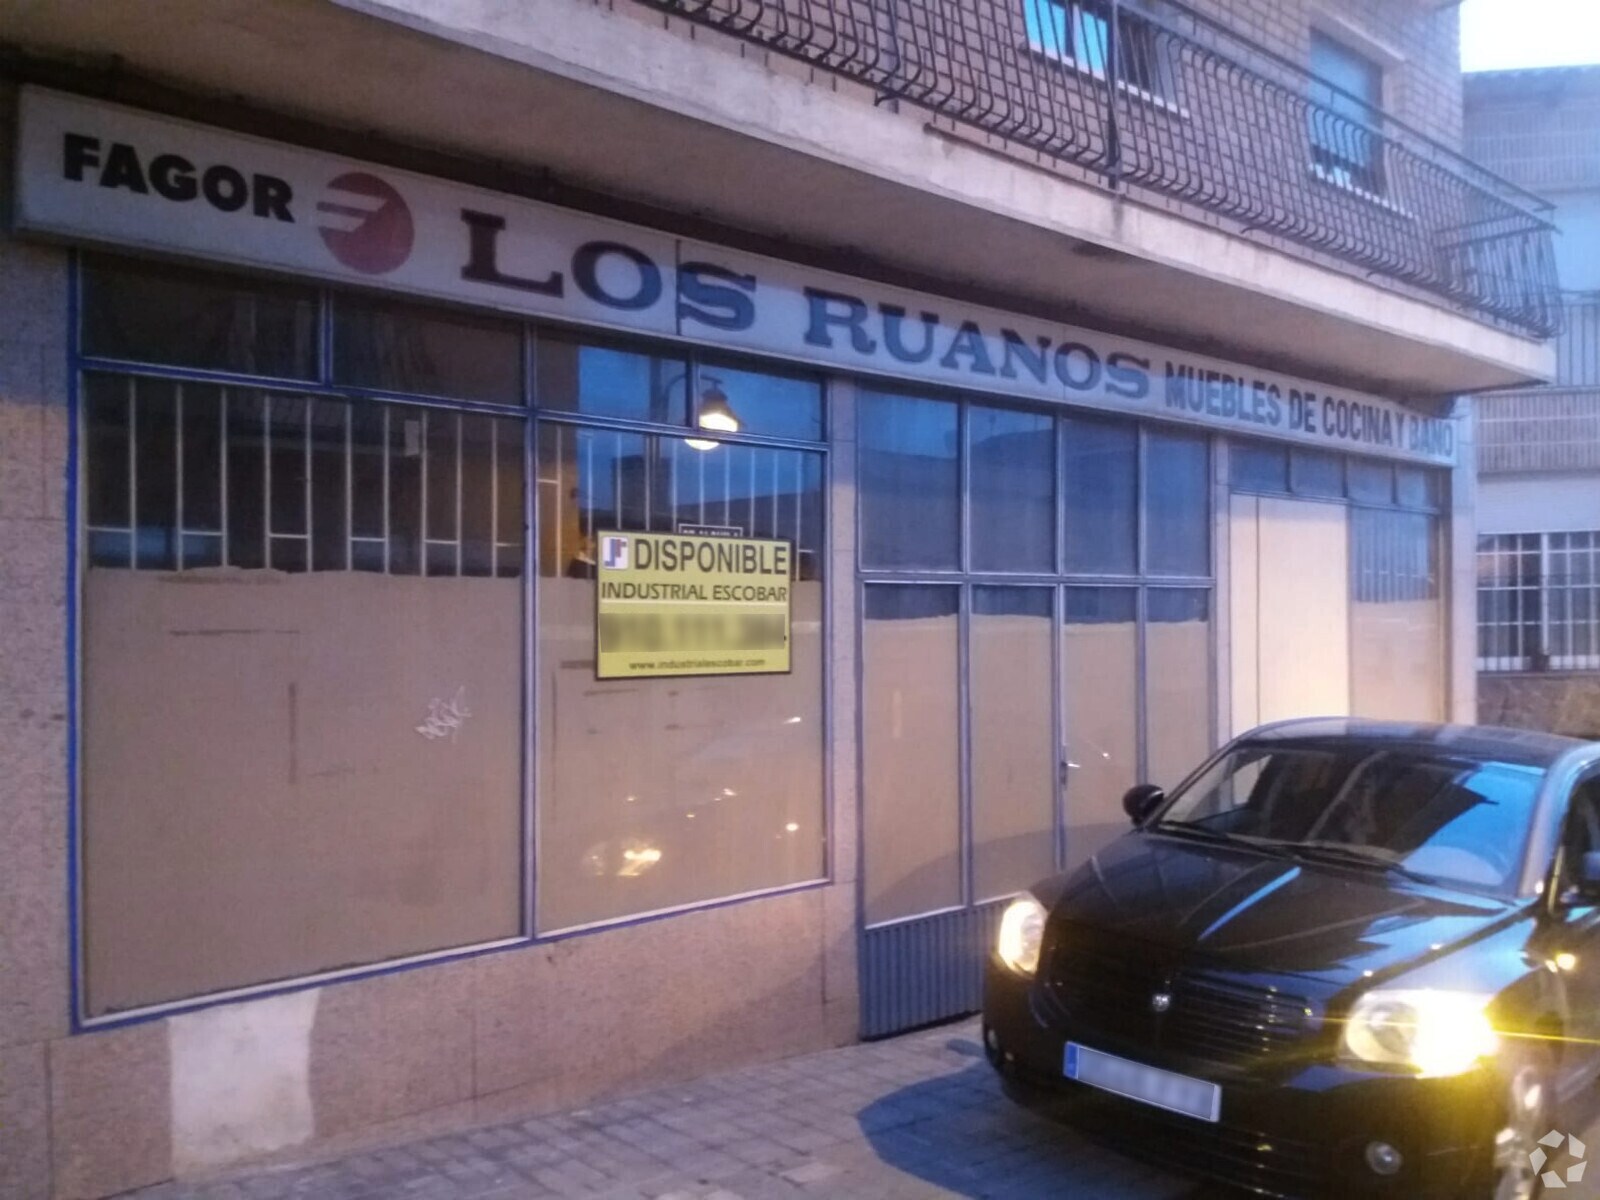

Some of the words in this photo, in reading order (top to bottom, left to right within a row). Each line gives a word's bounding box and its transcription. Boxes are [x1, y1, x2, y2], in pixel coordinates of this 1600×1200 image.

[63, 132, 295, 222] FAGOR
[460, 208, 757, 332] LOS
[803, 286, 1150, 399] RUANOS
[1165, 361, 1281, 427] MUEBLES
[1289, 388, 1316, 433] DE
[1322, 396, 1393, 446] COCINA
[1395, 411, 1405, 448] Y
[601, 582, 707, 601] INDUSTRIAL
[712, 585, 787, 602] ESCOBAR
[634, 538, 787, 575] DISPONIBLE
